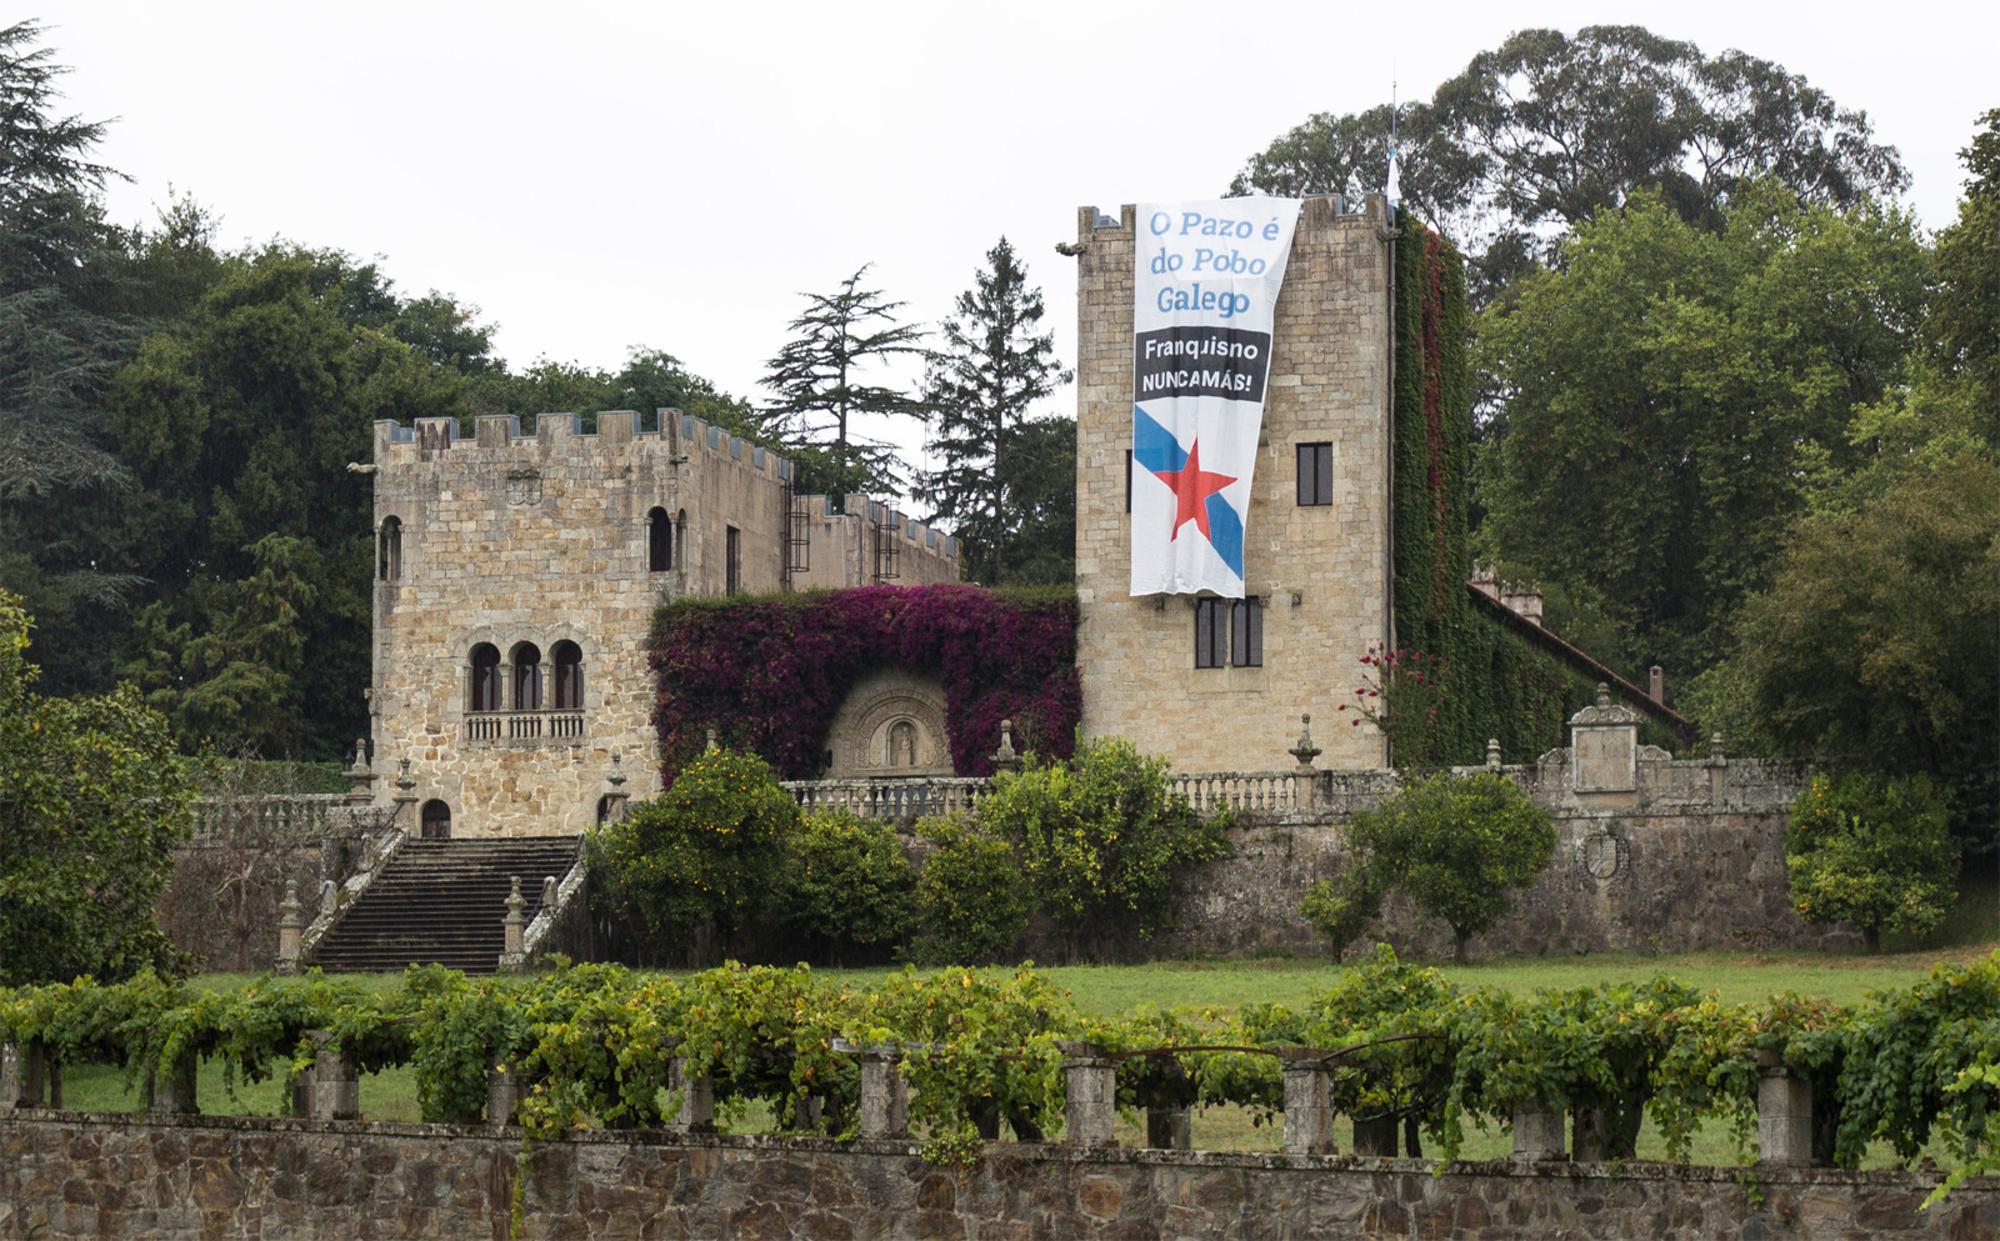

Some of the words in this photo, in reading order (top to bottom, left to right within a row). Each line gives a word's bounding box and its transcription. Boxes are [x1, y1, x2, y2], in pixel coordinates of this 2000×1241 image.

[1150, 211, 1172, 236] O
[1179, 212, 1253, 239] Pazo
[1262, 217, 1280, 241] é
[1151, 247, 1184, 275] do
[1192, 248, 1266, 276] Pobo
[1157, 282, 1250, 318] Galego
